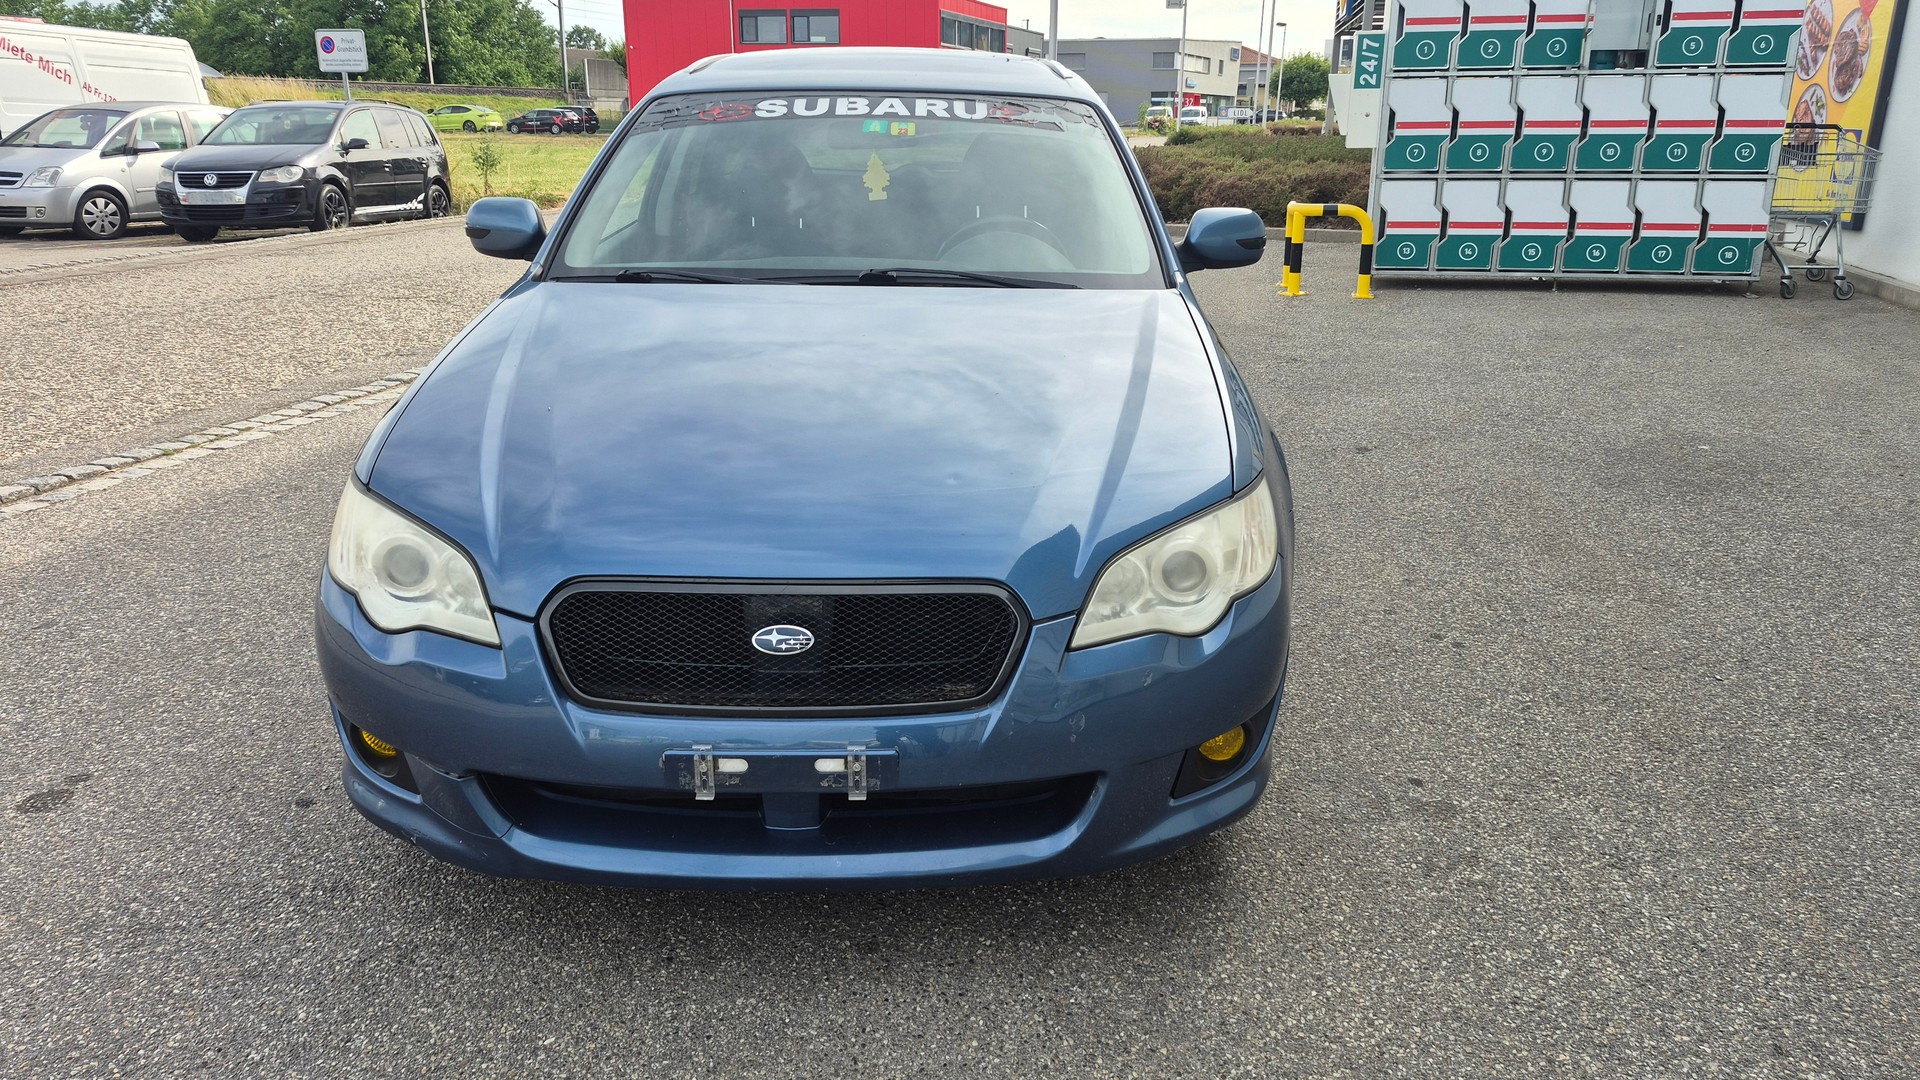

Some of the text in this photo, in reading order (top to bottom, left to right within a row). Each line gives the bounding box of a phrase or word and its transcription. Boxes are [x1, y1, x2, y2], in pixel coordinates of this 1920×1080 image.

[38, 56, 72, 85] Mich
[1360, 37, 1380, 86] 24/7
[82, 81, 92, 93] Ab
[754, 97, 988, 120] SUBARU
[1233, 109, 1248, 117] LIDL
